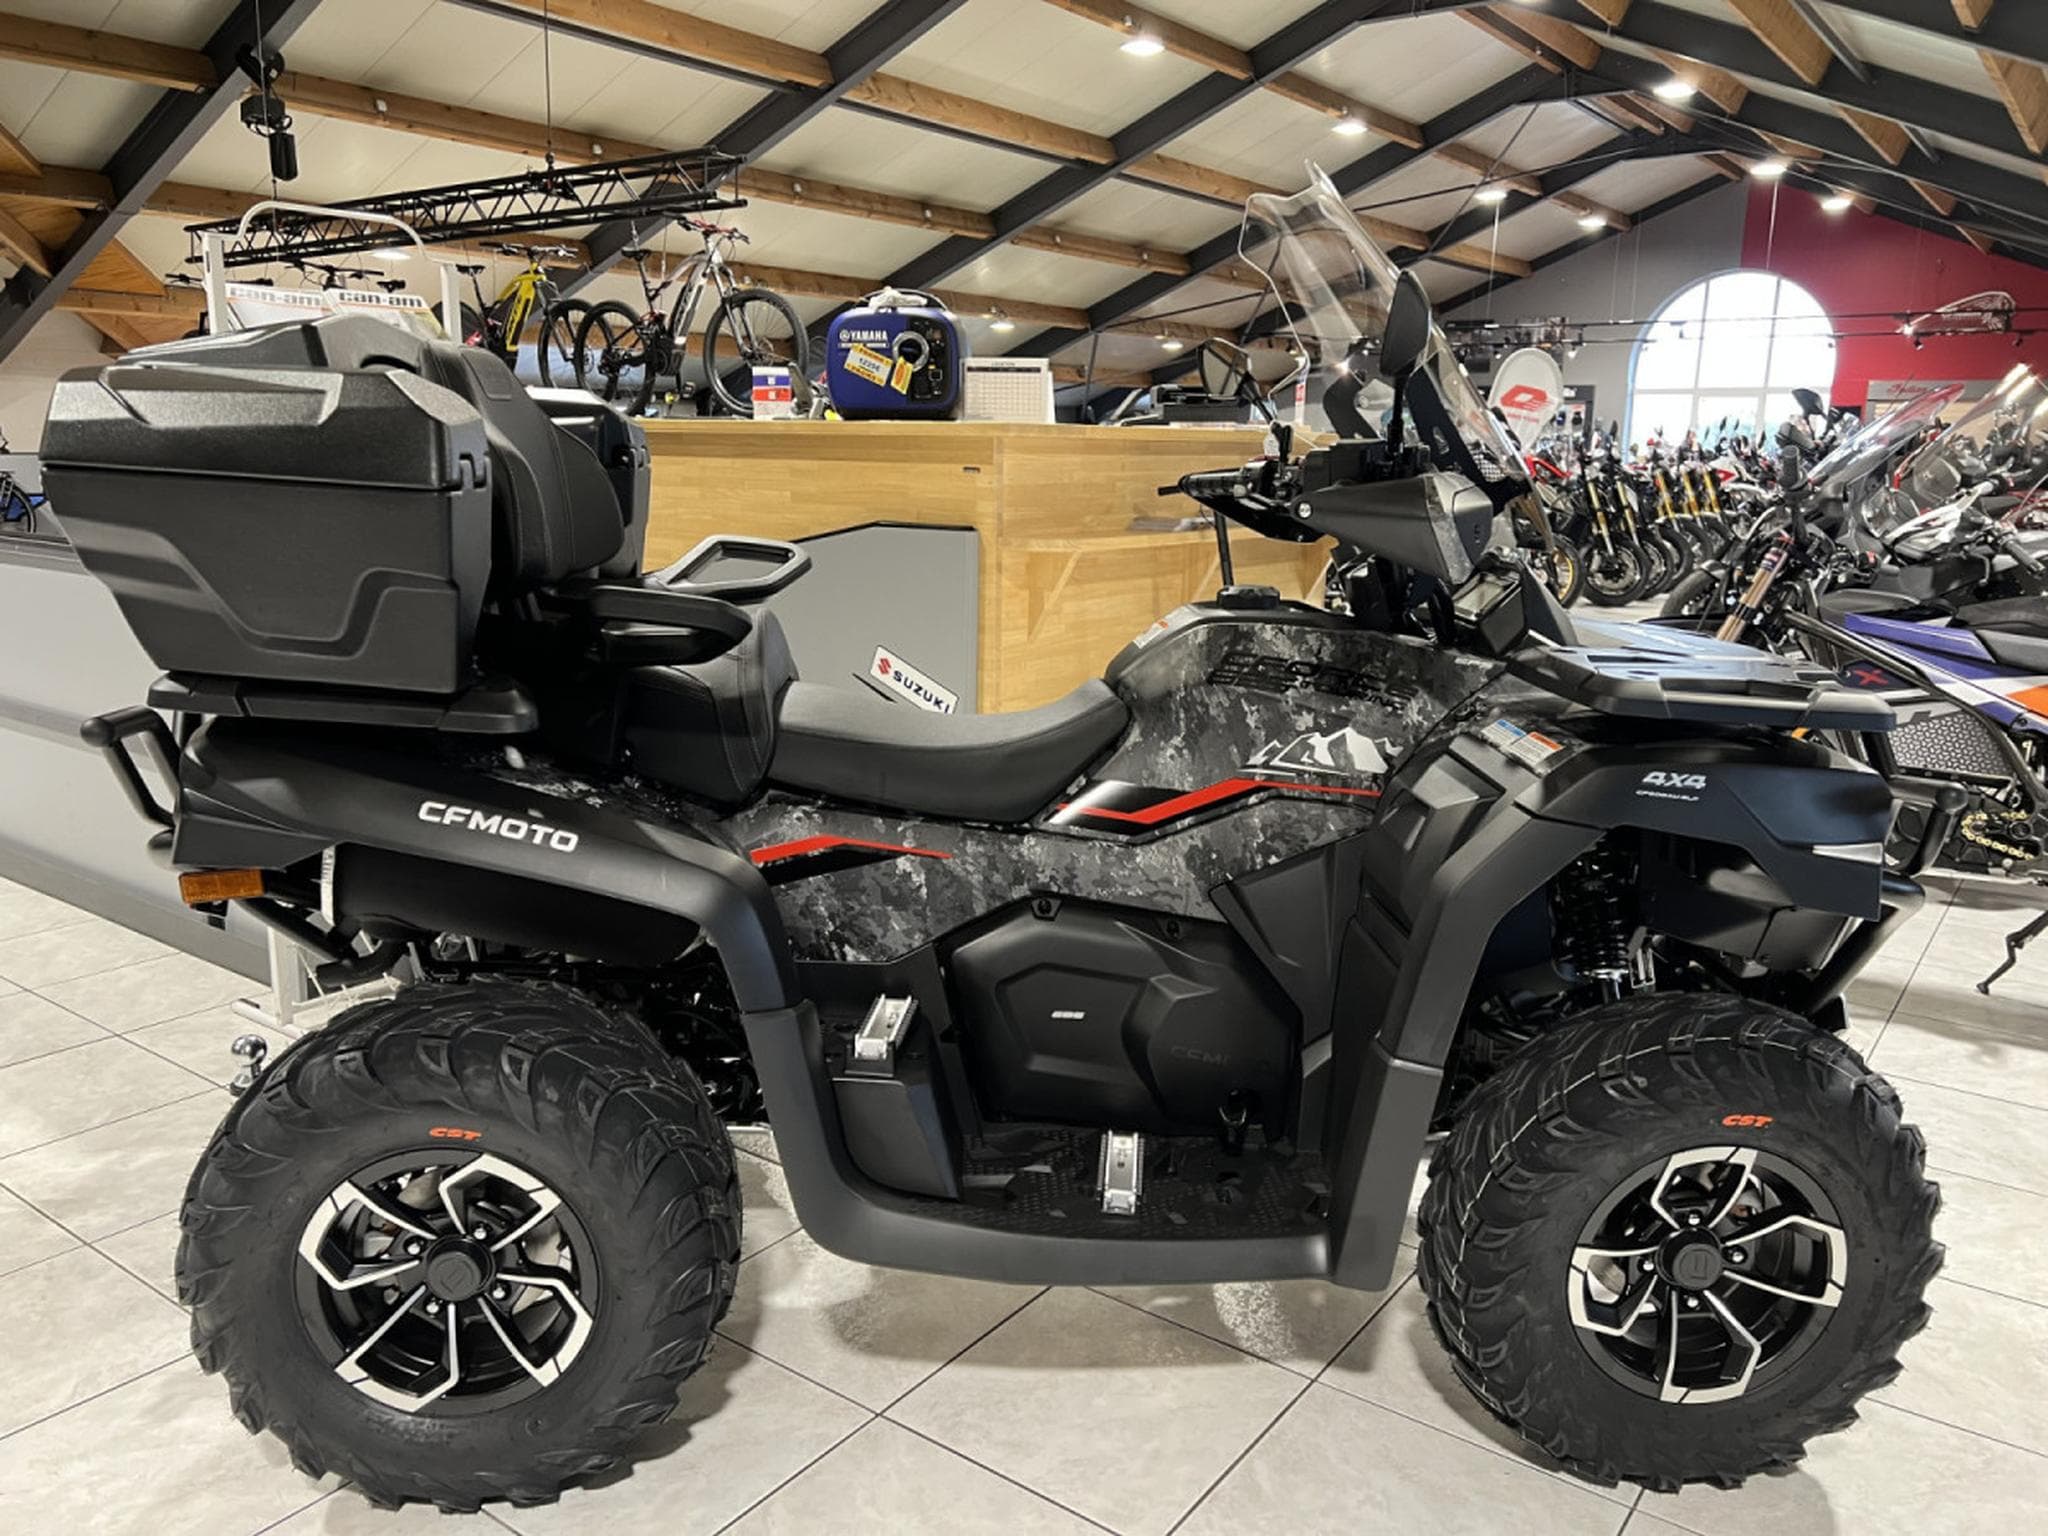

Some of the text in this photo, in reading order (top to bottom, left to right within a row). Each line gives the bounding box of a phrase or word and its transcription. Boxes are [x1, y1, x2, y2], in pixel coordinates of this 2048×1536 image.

[339, 291, 423, 308] can-am
[850, 330, 888, 341] YAMAHA
[893, 670, 950, 714] SUZUKI
[418, 801, 579, 853] CFMOTO
[1722, 1113, 1773, 1128] CST
[428, 1127, 482, 1141] CST
